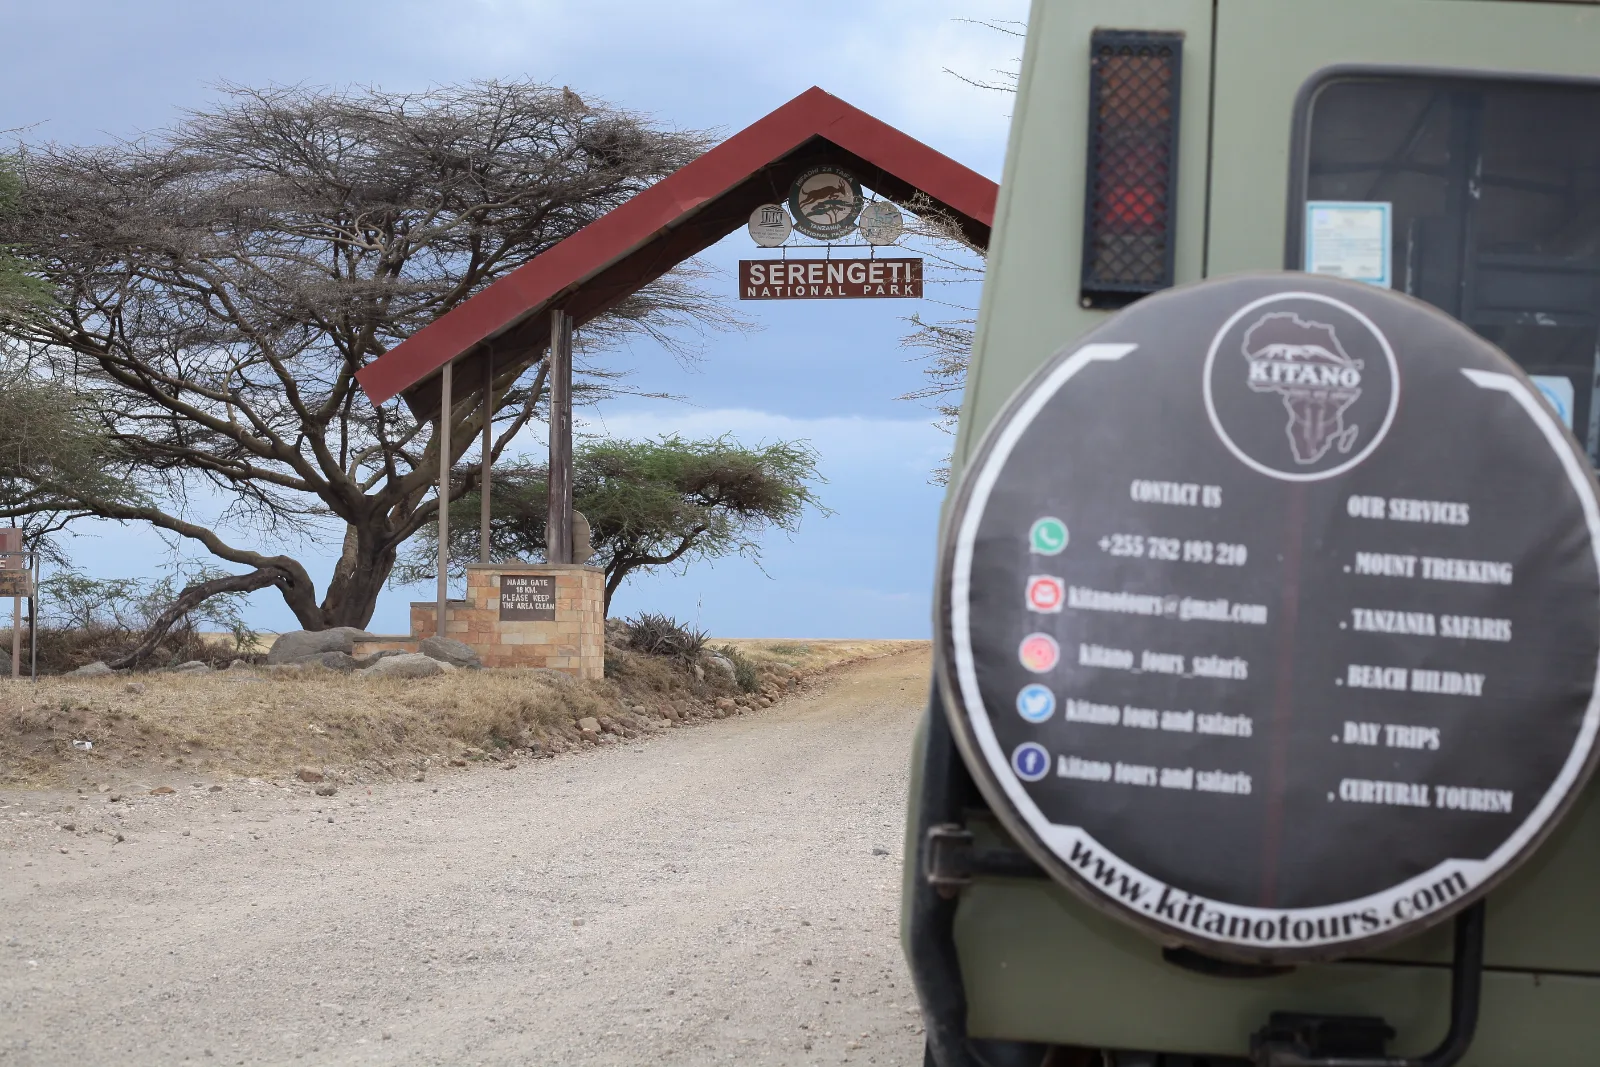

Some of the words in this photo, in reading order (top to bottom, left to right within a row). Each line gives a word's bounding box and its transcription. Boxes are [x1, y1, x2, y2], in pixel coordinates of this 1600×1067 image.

[798, 225, 829, 238] NATIONAL
[810, 222, 842, 231] TANZANIA
[749, 262, 911, 286] SERENGETI
[747, 286, 847, 297] NATIONAL
[863, 284, 914, 295] PARK
[1249, 360, 1362, 389] KITANO
[1130, 479, 1200, 507] CONTACT
[1202, 484, 1223, 508] US
[1347, 494, 1386, 519] OUR
[1389, 498, 1470, 526] SERVICES
[1097, 533, 1145, 558] +255
[1183, 540, 1214, 565] 193
[1215, 543, 1249, 567] 210
[506, 578, 527, 586] NAABI
[1355, 552, 1418, 579] MOUNT
[1420, 556, 1513, 585] TREKKING
[502, 593, 529, 602] PLEASE
[532, 594, 550, 602] KEEP
[502, 601, 514, 609] THE
[517, 602, 534, 610] AREA
[535, 602, 555, 610] CLEAN
[1351, 608, 1437, 637] TANZANIA
[1440, 614, 1512, 643] SAFARIS
[1347, 663, 1408, 691] BEACH
[1065, 698, 1121, 726] kitano
[1160, 709, 1195, 733] and
[1343, 720, 1381, 746] DAY
[1384, 724, 1441, 751] TRIPS
[1057, 754, 1112, 782] kitano
[1159, 767, 1194, 790] and
[1435, 785, 1514, 814] TOURISM
[1069, 839, 1470, 943] www.kitanotours.com
